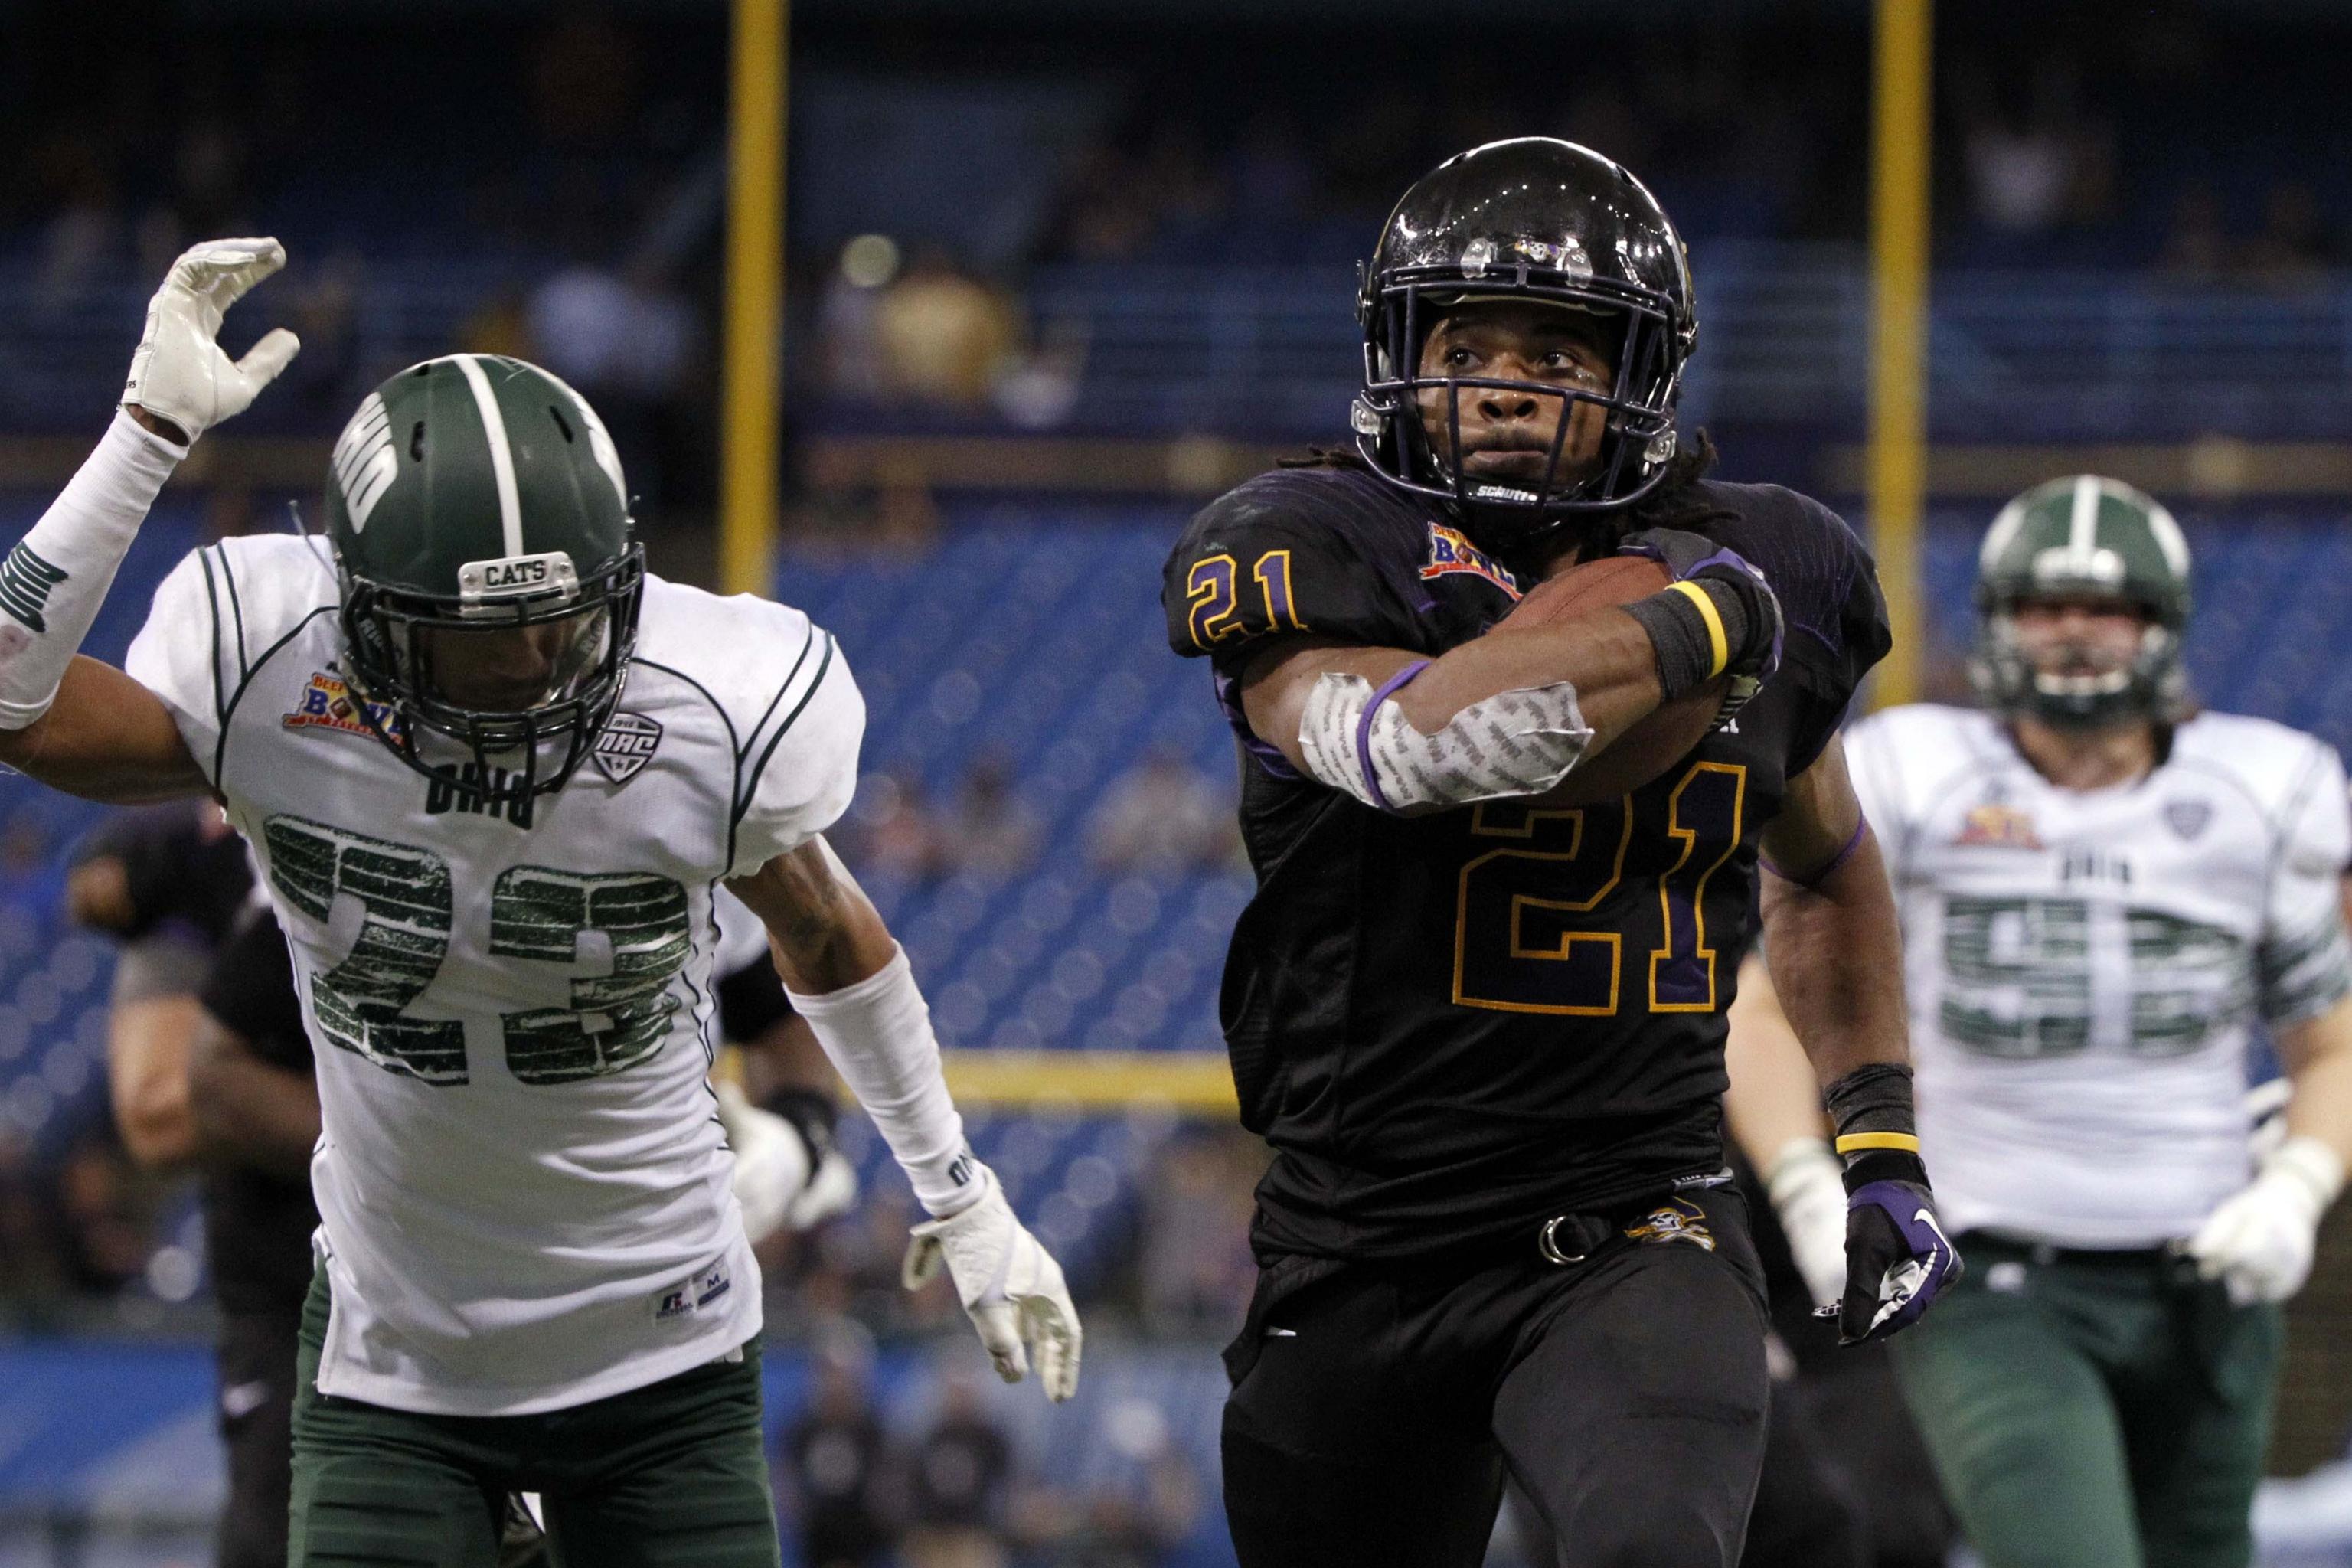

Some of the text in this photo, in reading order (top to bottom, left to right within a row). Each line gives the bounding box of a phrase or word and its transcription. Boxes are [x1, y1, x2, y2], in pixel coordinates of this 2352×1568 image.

[485, 560, 546, 586] CATS
[1186, 550, 1312, 650] 21
[1452, 761, 1746, 1016] 21
